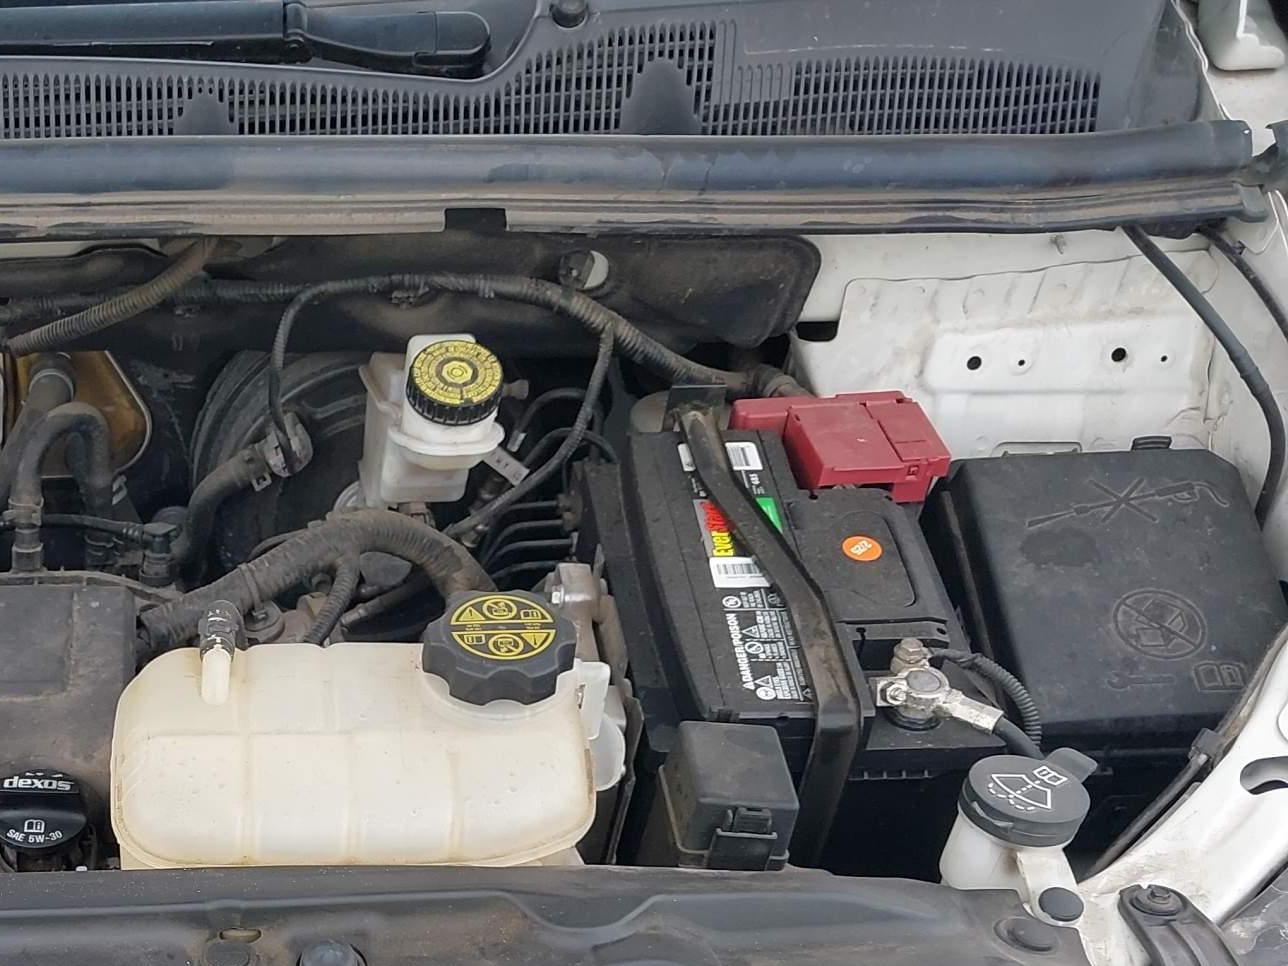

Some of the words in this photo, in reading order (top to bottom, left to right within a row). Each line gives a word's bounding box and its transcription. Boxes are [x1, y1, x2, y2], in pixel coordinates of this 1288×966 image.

[725, 613, 753, 682] DANGER/POISON
[3, 776, 74, 791] dexos
[6, 829, 26, 842] SAE
[28, 830, 63, 843] 5W-30
